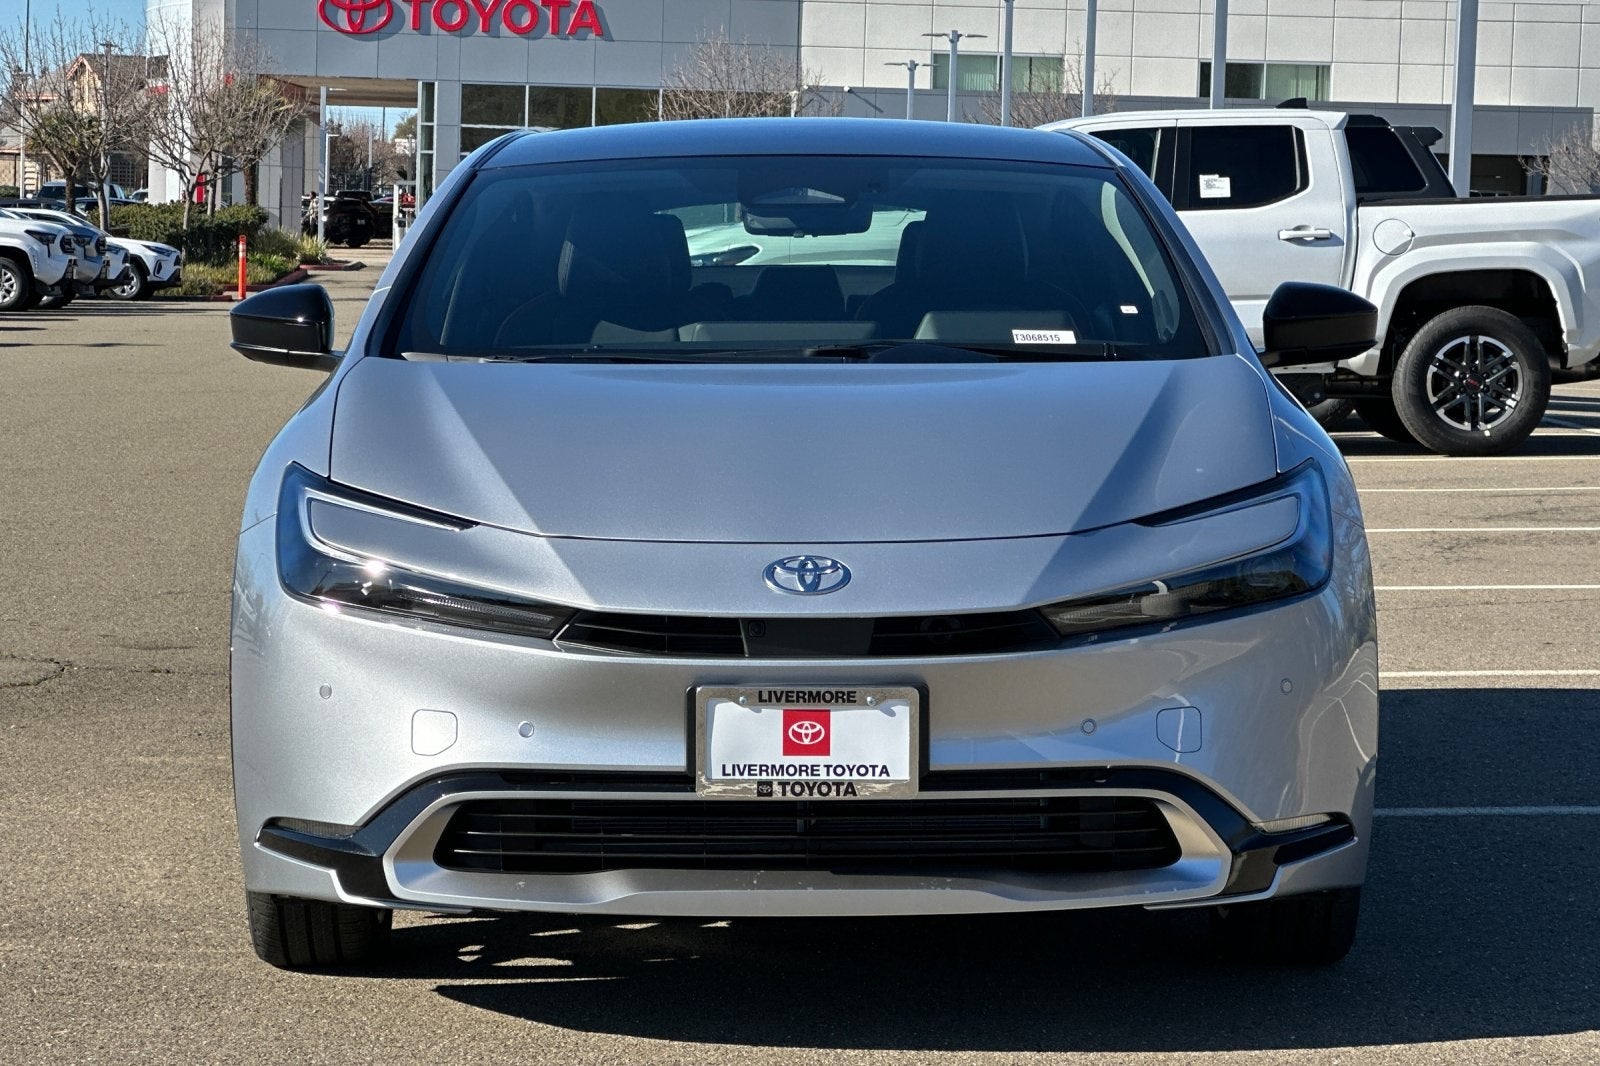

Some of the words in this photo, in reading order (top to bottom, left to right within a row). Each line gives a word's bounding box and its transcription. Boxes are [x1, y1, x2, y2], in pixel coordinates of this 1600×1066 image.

[402, 0, 603, 35] TOYOTA
[1014, 333, 1060, 342] T3068515
[758, 690, 857, 703] LIVERMORE
[722, 764, 821, 777] LIVERMORE
[823, 764, 890, 777] TOYOTA
[778, 781, 858, 797] TOYOTA
